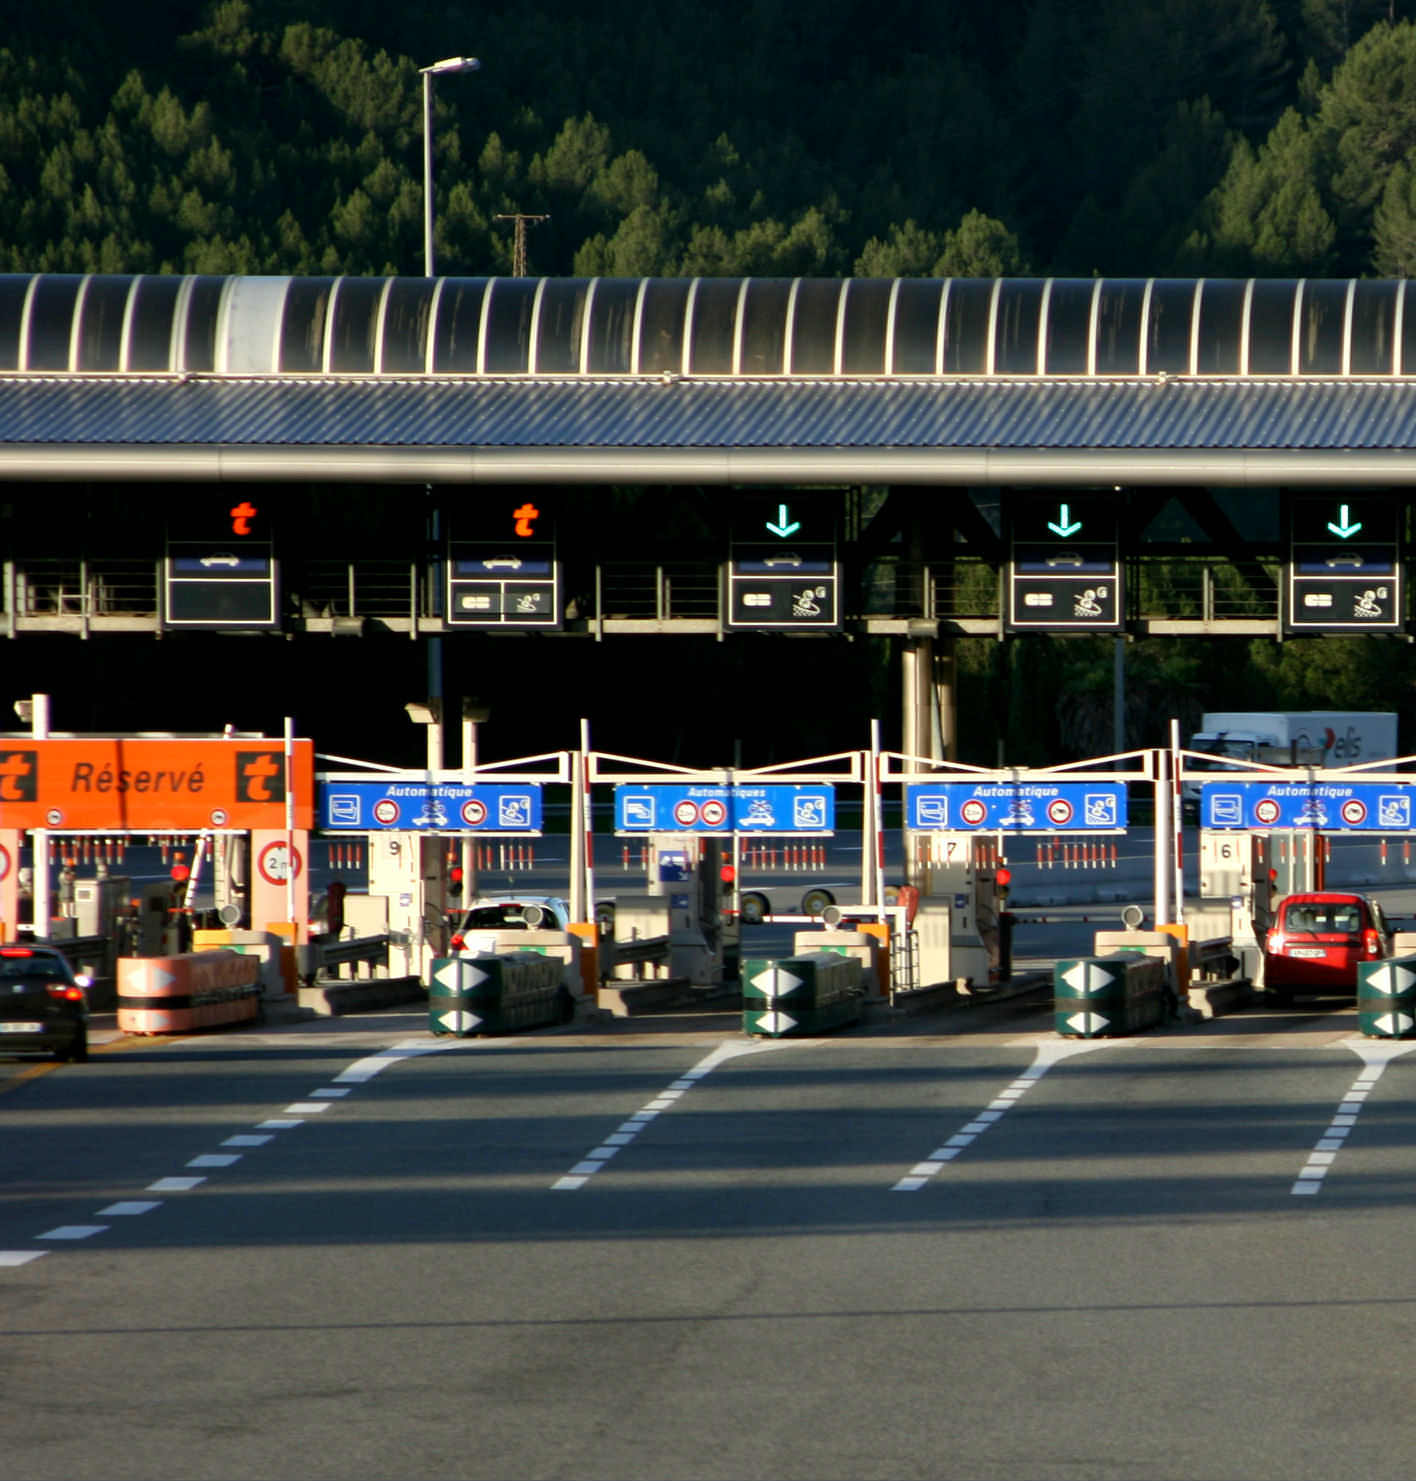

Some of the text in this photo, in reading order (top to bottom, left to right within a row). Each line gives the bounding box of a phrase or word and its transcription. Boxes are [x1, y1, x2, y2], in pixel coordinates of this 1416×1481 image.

[71, 762, 206, 793] Réservé
[386, 785, 473, 799] Automatique
[688, 787, 766, 799] Automatiques
[973, 785, 1059, 799] Automatique
[1267, 785, 1353, 799] Automatique
[390, 840, 400, 856] 9
[1221, 843, 1232, 859] 6
